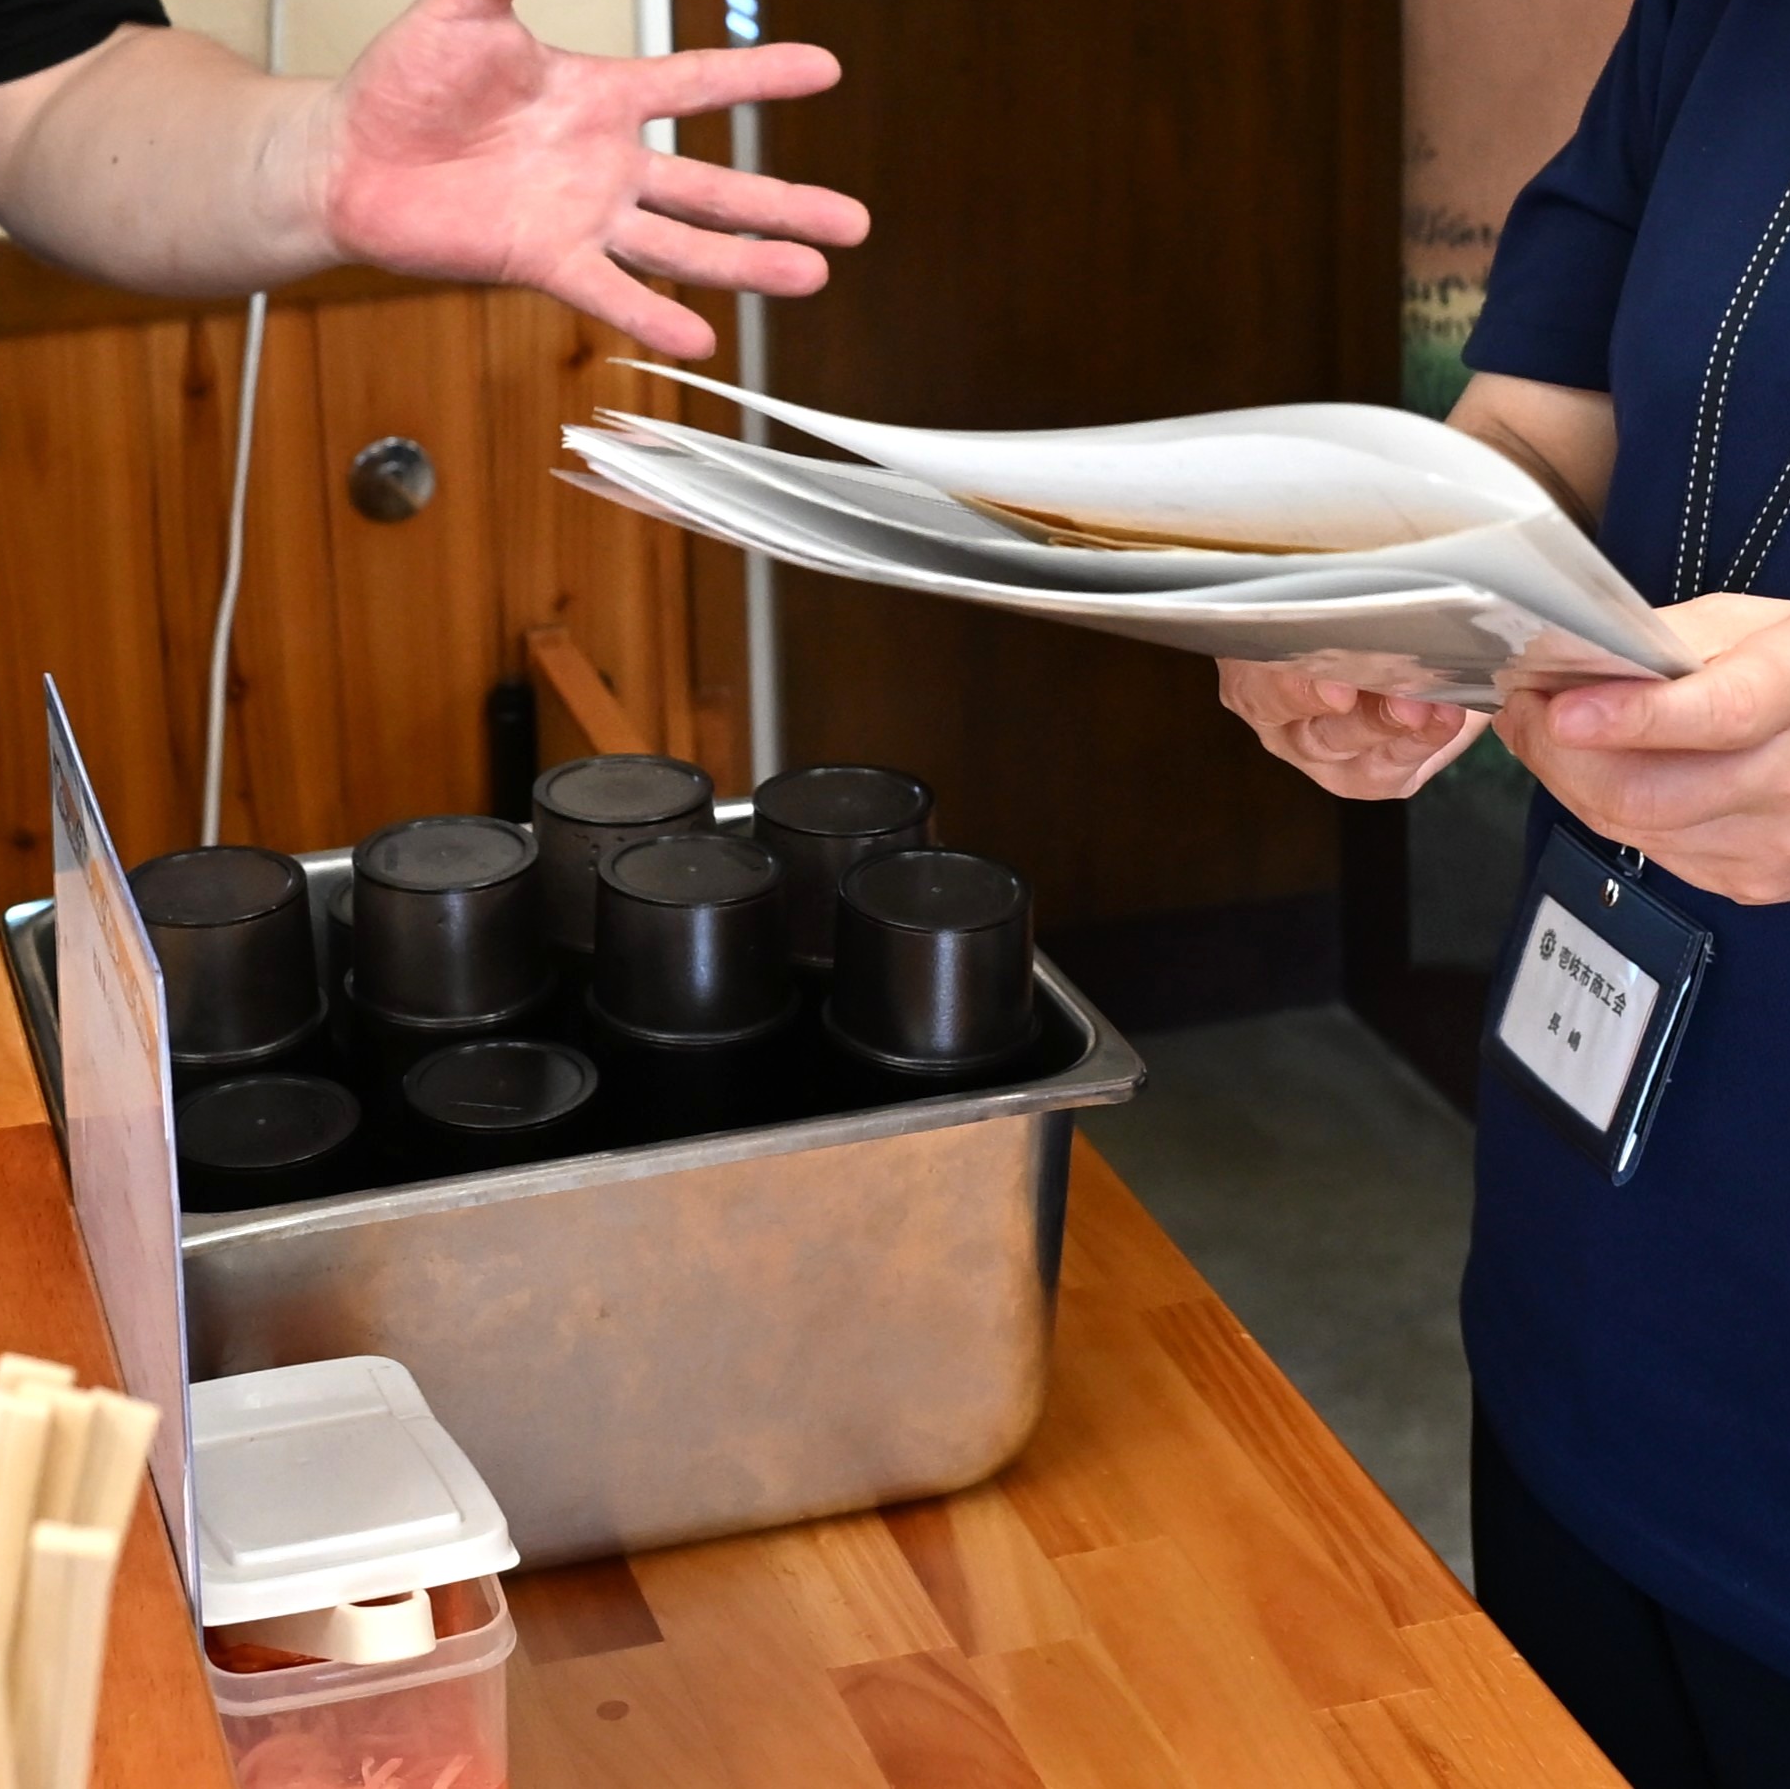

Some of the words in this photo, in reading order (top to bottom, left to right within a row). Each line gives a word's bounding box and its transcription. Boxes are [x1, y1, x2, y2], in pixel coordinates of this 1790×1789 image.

[1557, 945, 1628, 1019] 壱岐市商工会
